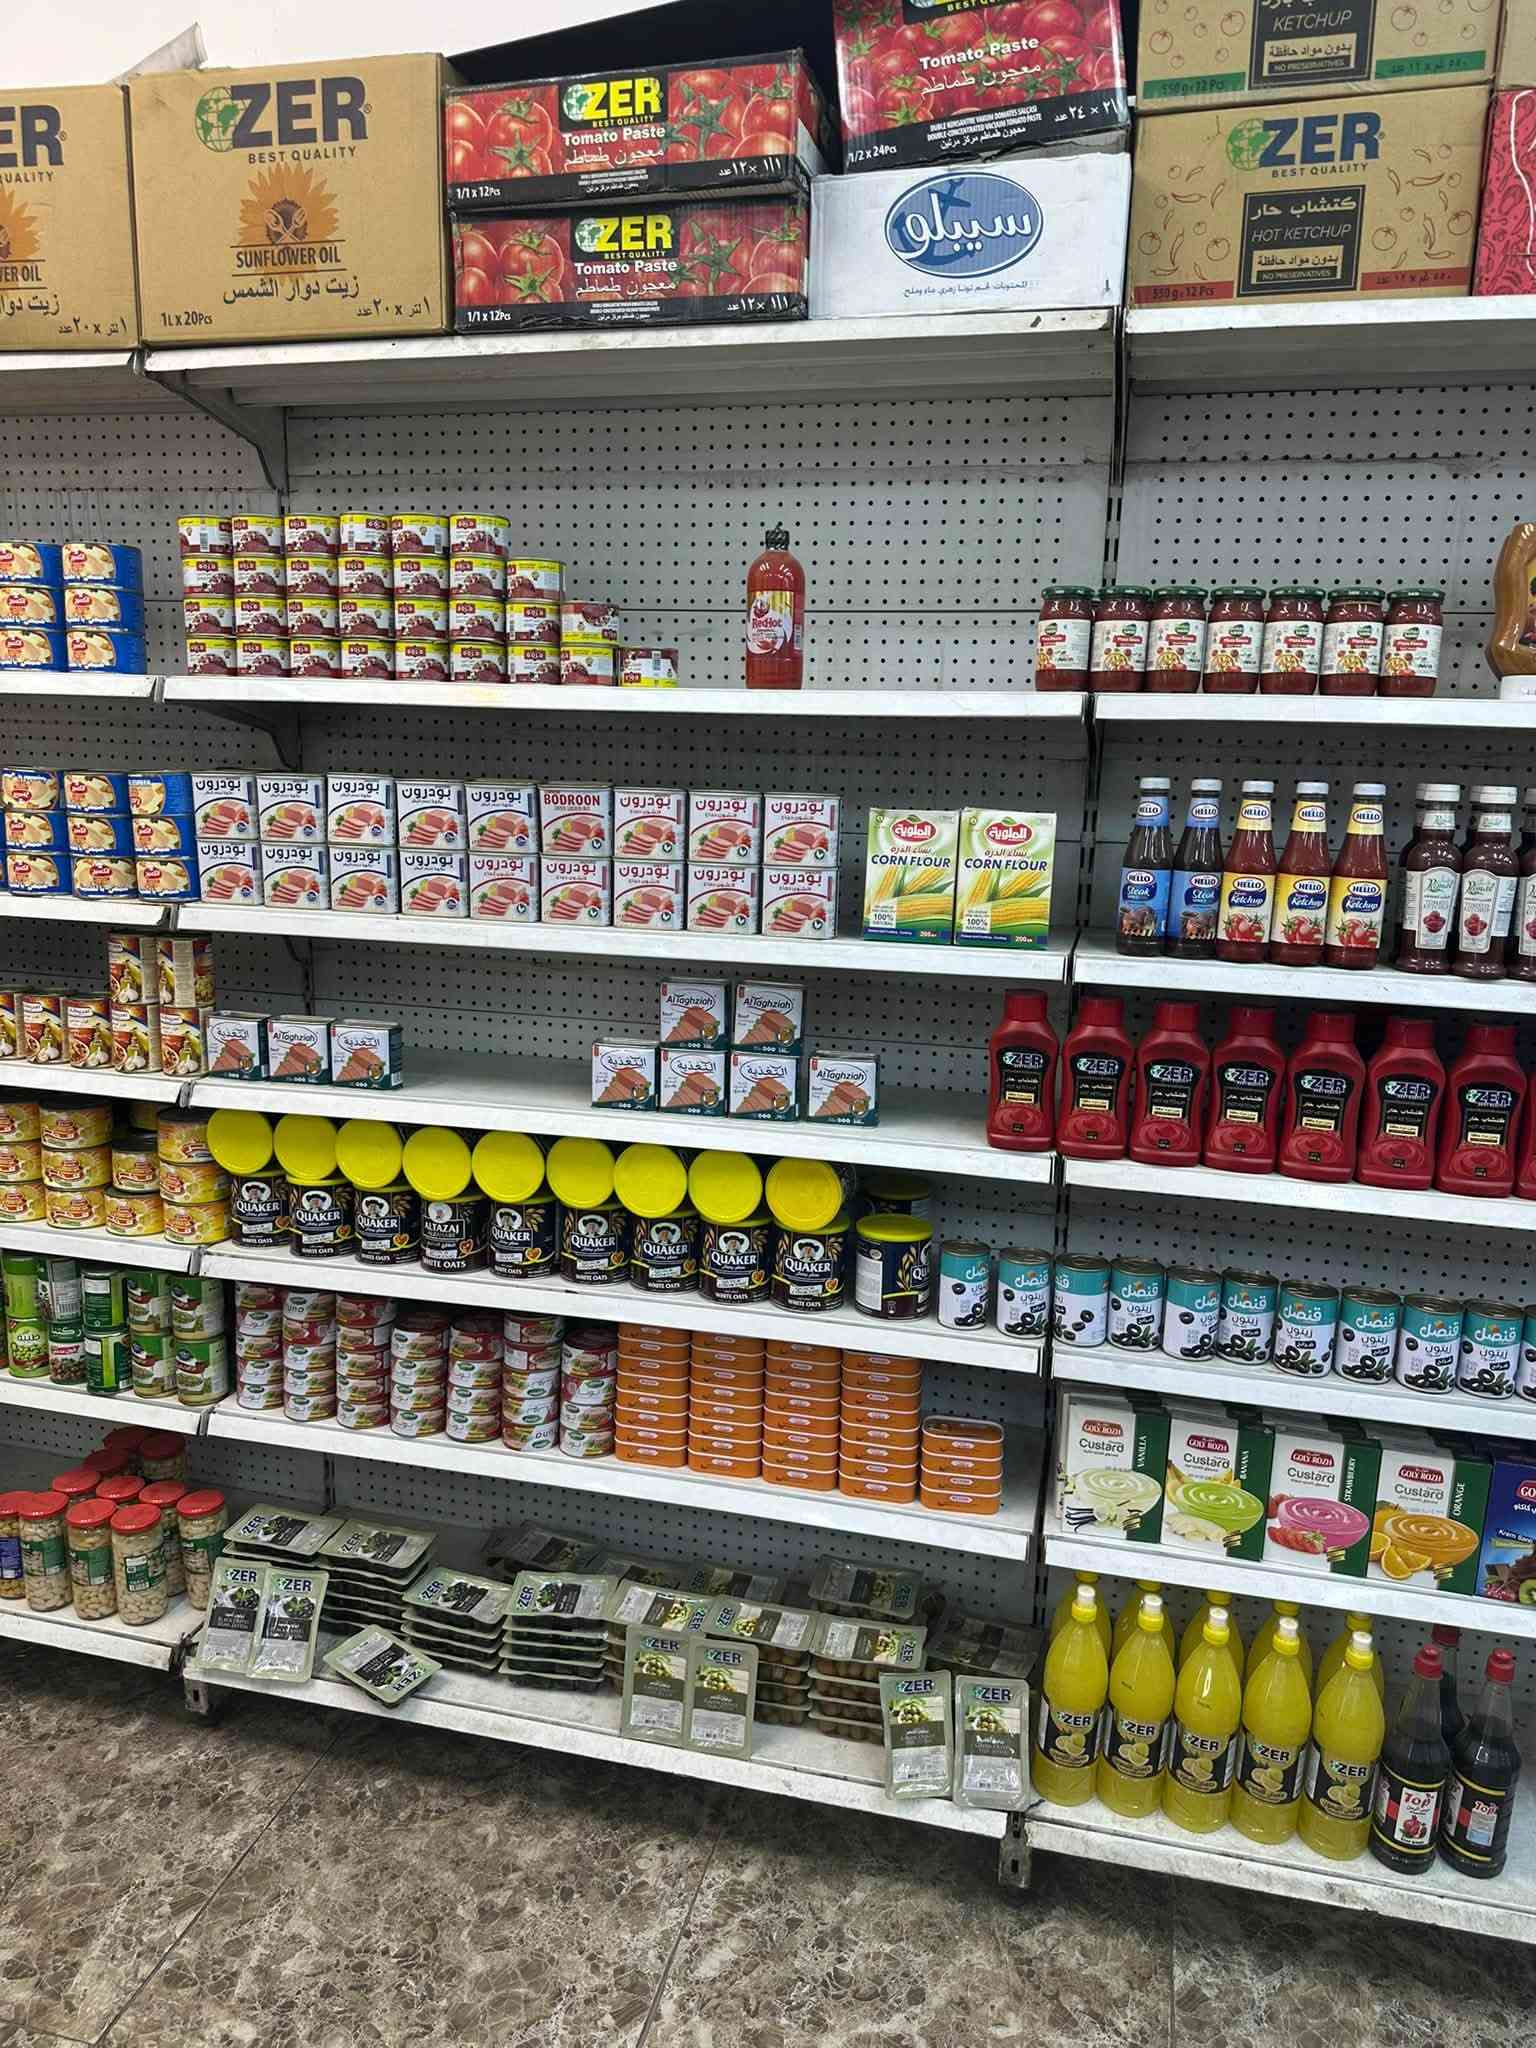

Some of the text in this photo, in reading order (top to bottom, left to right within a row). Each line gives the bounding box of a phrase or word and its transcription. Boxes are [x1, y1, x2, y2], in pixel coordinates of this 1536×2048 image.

[1273, 10, 1352, 32] KETCHUP
[920, 37, 1039, 70] Tomato Paste
[1302, 45, 1322, 56] مواد
[982, 64, 1041, 86] معجون
[583, 78, 661, 118] ZER
[230, 76, 367, 148] ZER
[592, 116, 654, 128] BEST QUALITY
[563, 126, 665, 146] Tomato Paste
[1260, 111, 1381, 167] ZER
[248, 147, 357, 164] BEST QUALITY
[615, 147, 664, 164] معجون
[1272, 162, 1369, 178] BEST QUALITY
[1251, 197, 1357, 221] كتشاب حار
[595, 214, 673, 252] ZER
[897, 193, 1032, 259] سيبلو
[1252, 223, 1352, 242] HOT KETCHUP
[236, 245, 341, 269] SUNFLOWER OIL
[604, 249, 665, 259] BEST QUALITY
[21, 265, 42, 282] OIL
[575, 259, 677, 275] Tomato Paste
[224, 276, 359, 304] زيت دوار الشمس
[626, 279, 677, 296] معجون
[27, 294, 60, 317] زيت
[195, 778, 240, 790] بودرون
[261, 781, 308, 794] بودرون
[332, 780, 380, 793] بودرون
[401, 786, 451, 799] بودرون
[471, 790, 521, 802] بودرون
[544, 793, 600, 806] BODROON
[620, 796, 671, 809] بودرون
[696, 800, 747, 812] بودرون
[771, 801, 824, 815] بودرون
[1195, 807, 1217, 816] HELLO
[1243, 807, 1267, 817] HELLO
[1301, 808, 1324, 819] HELLO
[1356, 812, 1380, 821] HELLO
[201, 844, 246, 857] بودرون
[266, 847, 312, 861] بودرون
[872, 855, 951, 867] CORN FLOUR
[964, 859, 1047, 871] CORN FLOUR
[1194, 877, 1216, 886] HELLO
[1235, 880, 1262, 889] HELLO
[1298, 881, 1322, 894] HELLO
[1353, 885, 1377, 894] HELLO
[1231, 895, 1263, 905] Ketchup
[1291, 894, 1323, 909] Ketchup
[1344, 899, 1378, 910] Ketchup
[874, 913, 893, 921] 100%
[1013, 1054, 1043, 1066] ZER
[1086, 1059, 1118, 1072] ZER
[1160, 1066, 1192, 1080] ZER
[1234, 1068, 1268, 1085] ZER
[1311, 1076, 1346, 1091] ZER
[1395, 1082, 1429, 1097] ZER
[1476, 1091, 1511, 1105] ZER
[237, 1200, 280, 1212] QUAKER
[296, 1210, 341, 1222] QUAKER
[358, 1217, 398, 1229] QUAKER
[491, 1228, 530, 1241] QUAKER
[571, 1235, 616, 1247] QUAKER
[643, 1243, 688, 1255] QUAKER
[443, 1260, 466, 1269] OATS
[711, 1252, 757, 1265] QUAKER
[785, 1259, 831, 1272] QUAKER
[1015, 1270, 1049, 1288] قنصل
[1121, 1282, 1159, 1298] قنصل
[1227, 1291, 1266, 1311] قنصل
[1283, 1303, 1322, 1321] قنصل
[1355, 1311, 1394, 1329] قنصل
[1079, 1438, 1124, 1452] Custard
[1137, 1435, 1147, 1468] VANILLA
[1183, 1453, 1230, 1469] Custard
[1287, 1467, 1336, 1484] Custard
[1394, 1483, 1444, 1500] Custard
[1452, 1482, 1465, 1516] ORANGE
[242, 1515, 265, 1534] ZER
[342, 1533, 362, 1553] ZER
[232, 1569, 257, 1583] ZER
[283, 1578, 312, 1591] ZER
[423, 1580, 444, 1600] ZER
[518, 1585, 535, 1609] ZER
[717, 1607, 733, 1626] ZER
[650, 1639, 679, 1650] ZER
[713, 1651, 742, 1664] ZER
[904, 1680, 934, 1693] ZER
[981, 1688, 1012, 1701] ZER
[1065, 1714, 1091, 1725] ZER
[1127, 1723, 1155, 1736] ZER
[1190, 1736, 1219, 1751] ZER
[1260, 1744, 1290, 1761] ZER
[1338, 1763, 1367, 1777] ZER
[1404, 1792, 1430, 1807] Top
